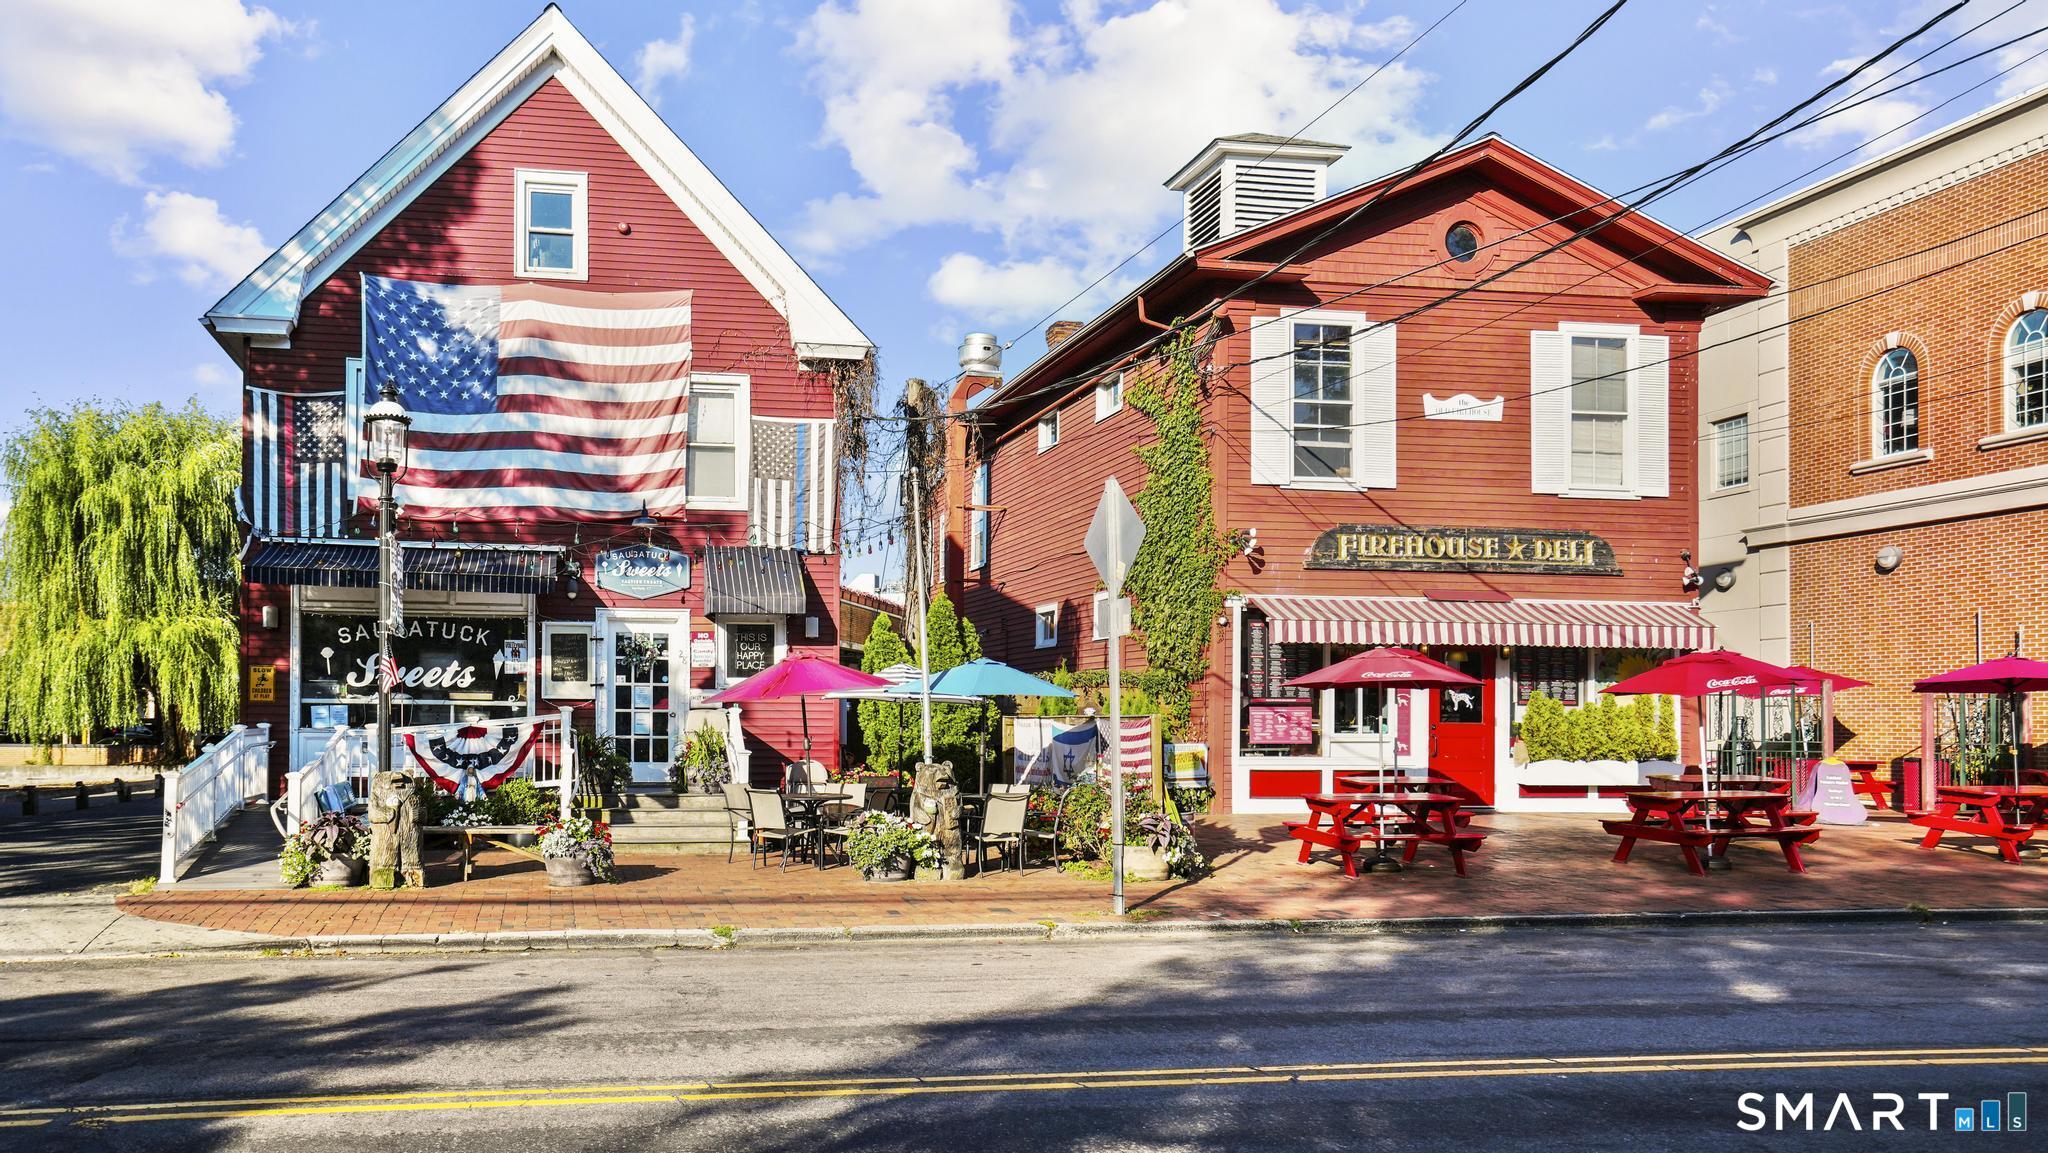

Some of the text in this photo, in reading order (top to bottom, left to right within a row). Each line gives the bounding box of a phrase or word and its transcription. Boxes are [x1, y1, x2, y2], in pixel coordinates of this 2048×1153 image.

[1336, 532, 1595, 565] FIREHOUSE DELI
[612, 560, 672, 577] Sweets
[736, 633, 767, 642] THIS IS
[740, 643, 760, 651] OUR
[736, 652, 765, 660] HAPPY
[736, 661, 765, 669] PLACE
[1707, 675, 1758, 688] Coca-Cola
